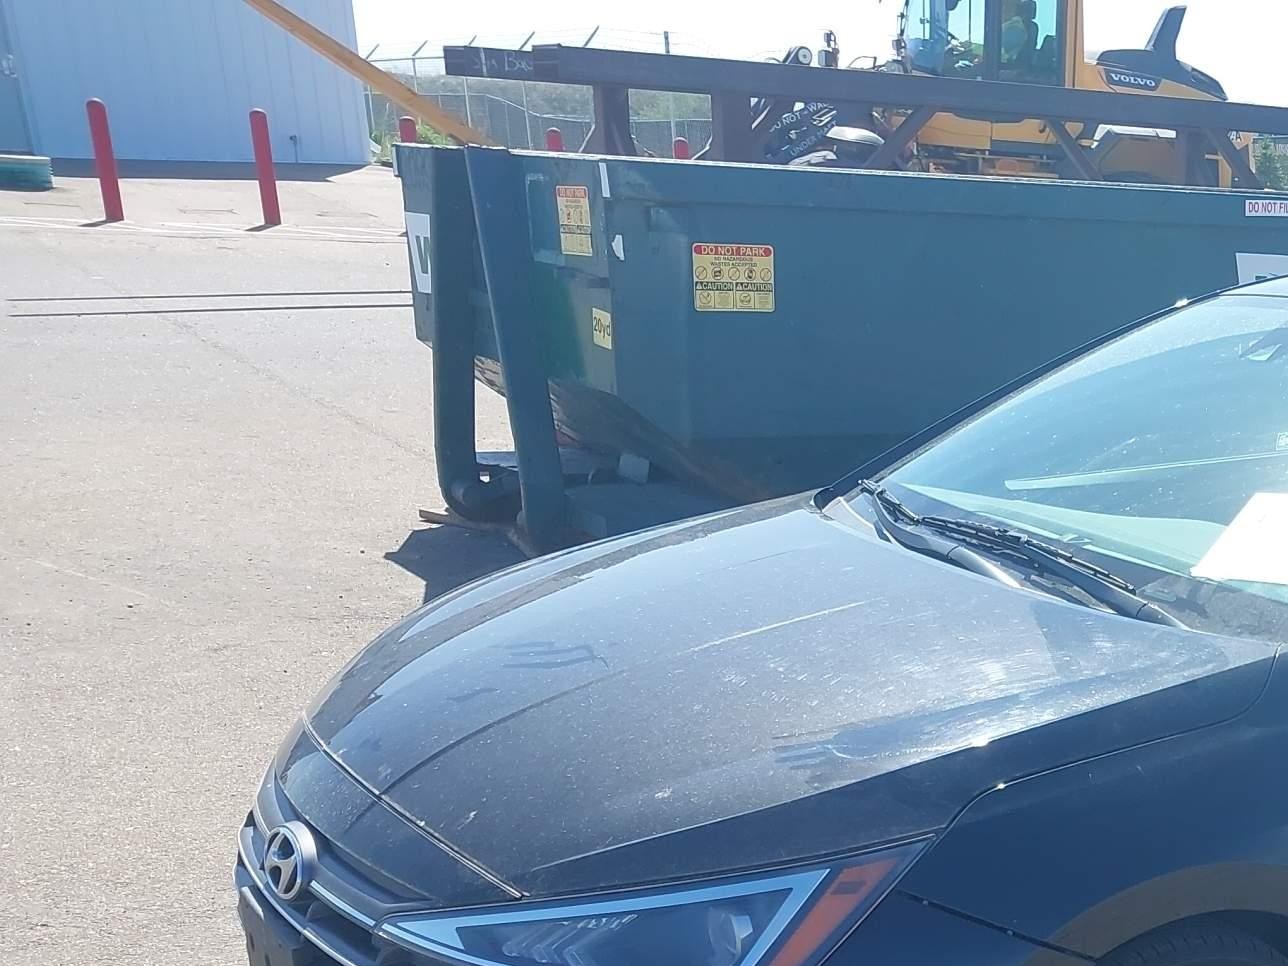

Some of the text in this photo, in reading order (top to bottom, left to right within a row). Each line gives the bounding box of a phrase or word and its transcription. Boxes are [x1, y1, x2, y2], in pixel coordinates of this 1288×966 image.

[1110, 73, 1155, 87] VOLVO
[782, 111, 801, 126] NOT
[1248, 201, 1259, 213] DO
[1262, 202, 1277, 213] NOT
[701, 246, 765, 257] DO NOT PARK
[702, 282, 733, 290] CAUTION
[743, 283, 772, 291] CAUTION
[594, 316, 611, 339] 20yd
